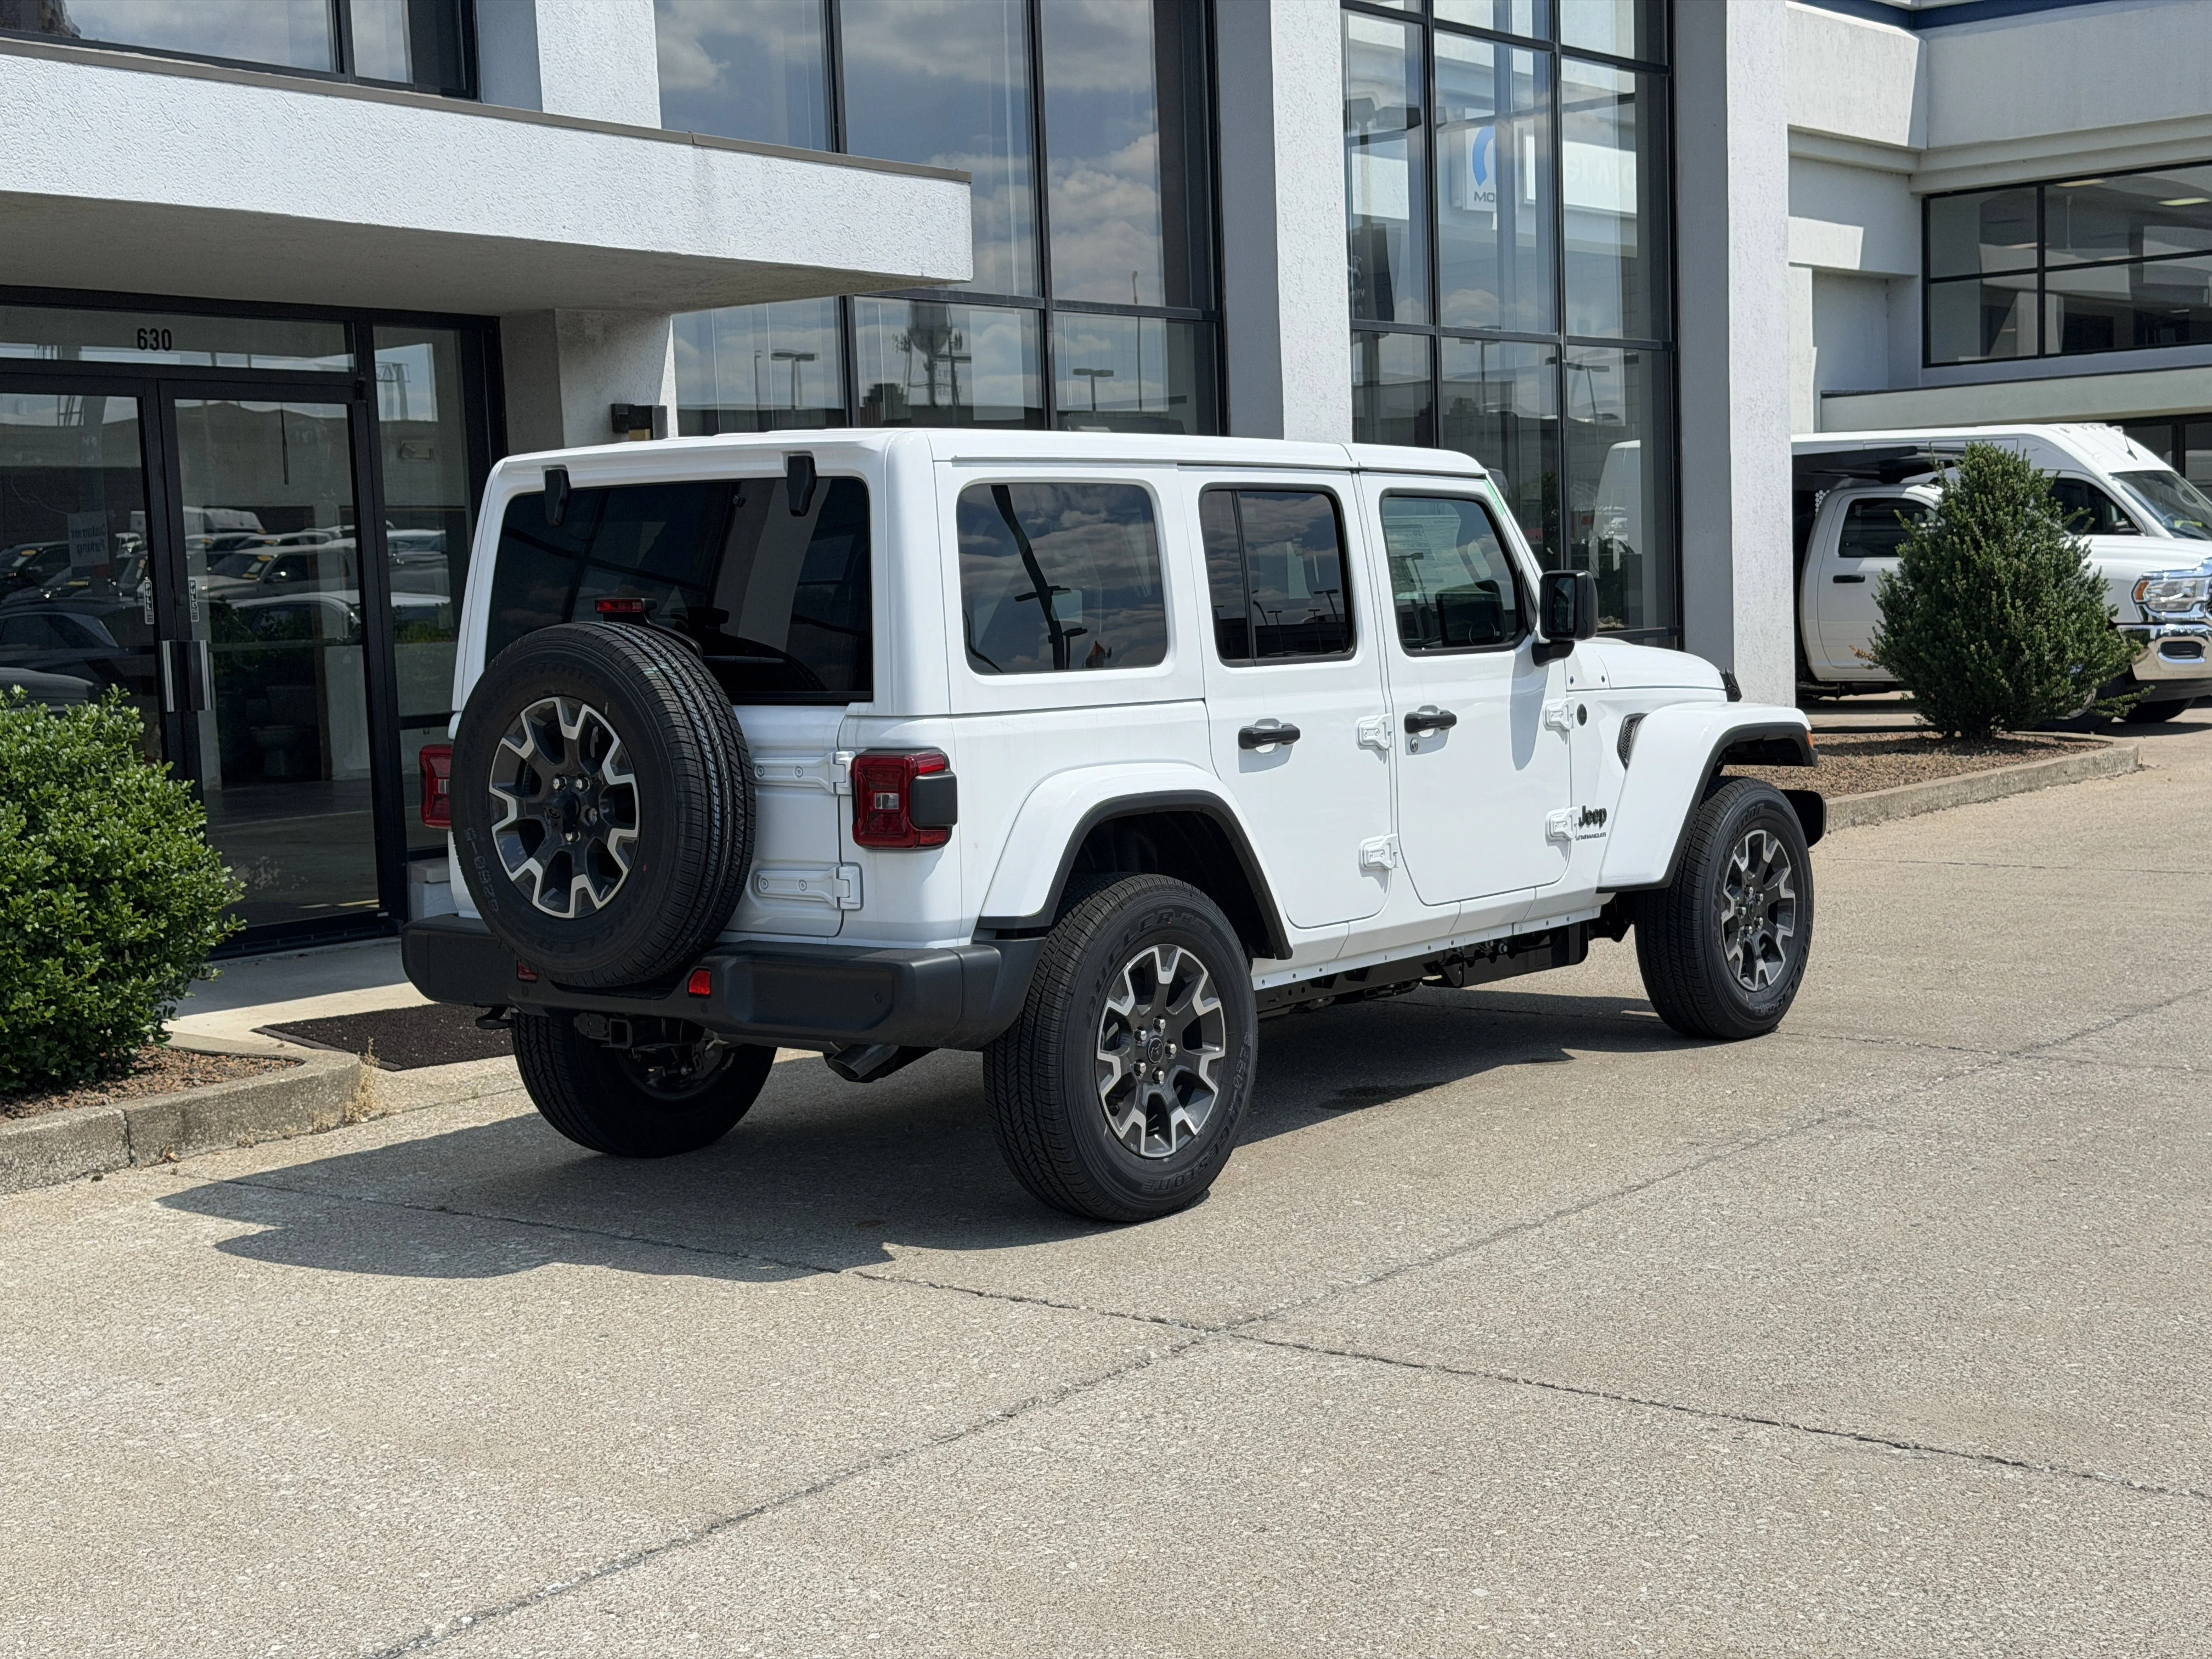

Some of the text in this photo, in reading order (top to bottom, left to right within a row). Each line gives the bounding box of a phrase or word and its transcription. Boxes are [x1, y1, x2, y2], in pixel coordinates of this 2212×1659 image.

[137, 328, 172, 351] 630
[1578, 805, 1607, 830] Jeep
[1580, 832, 1606, 840] WRANGLER
